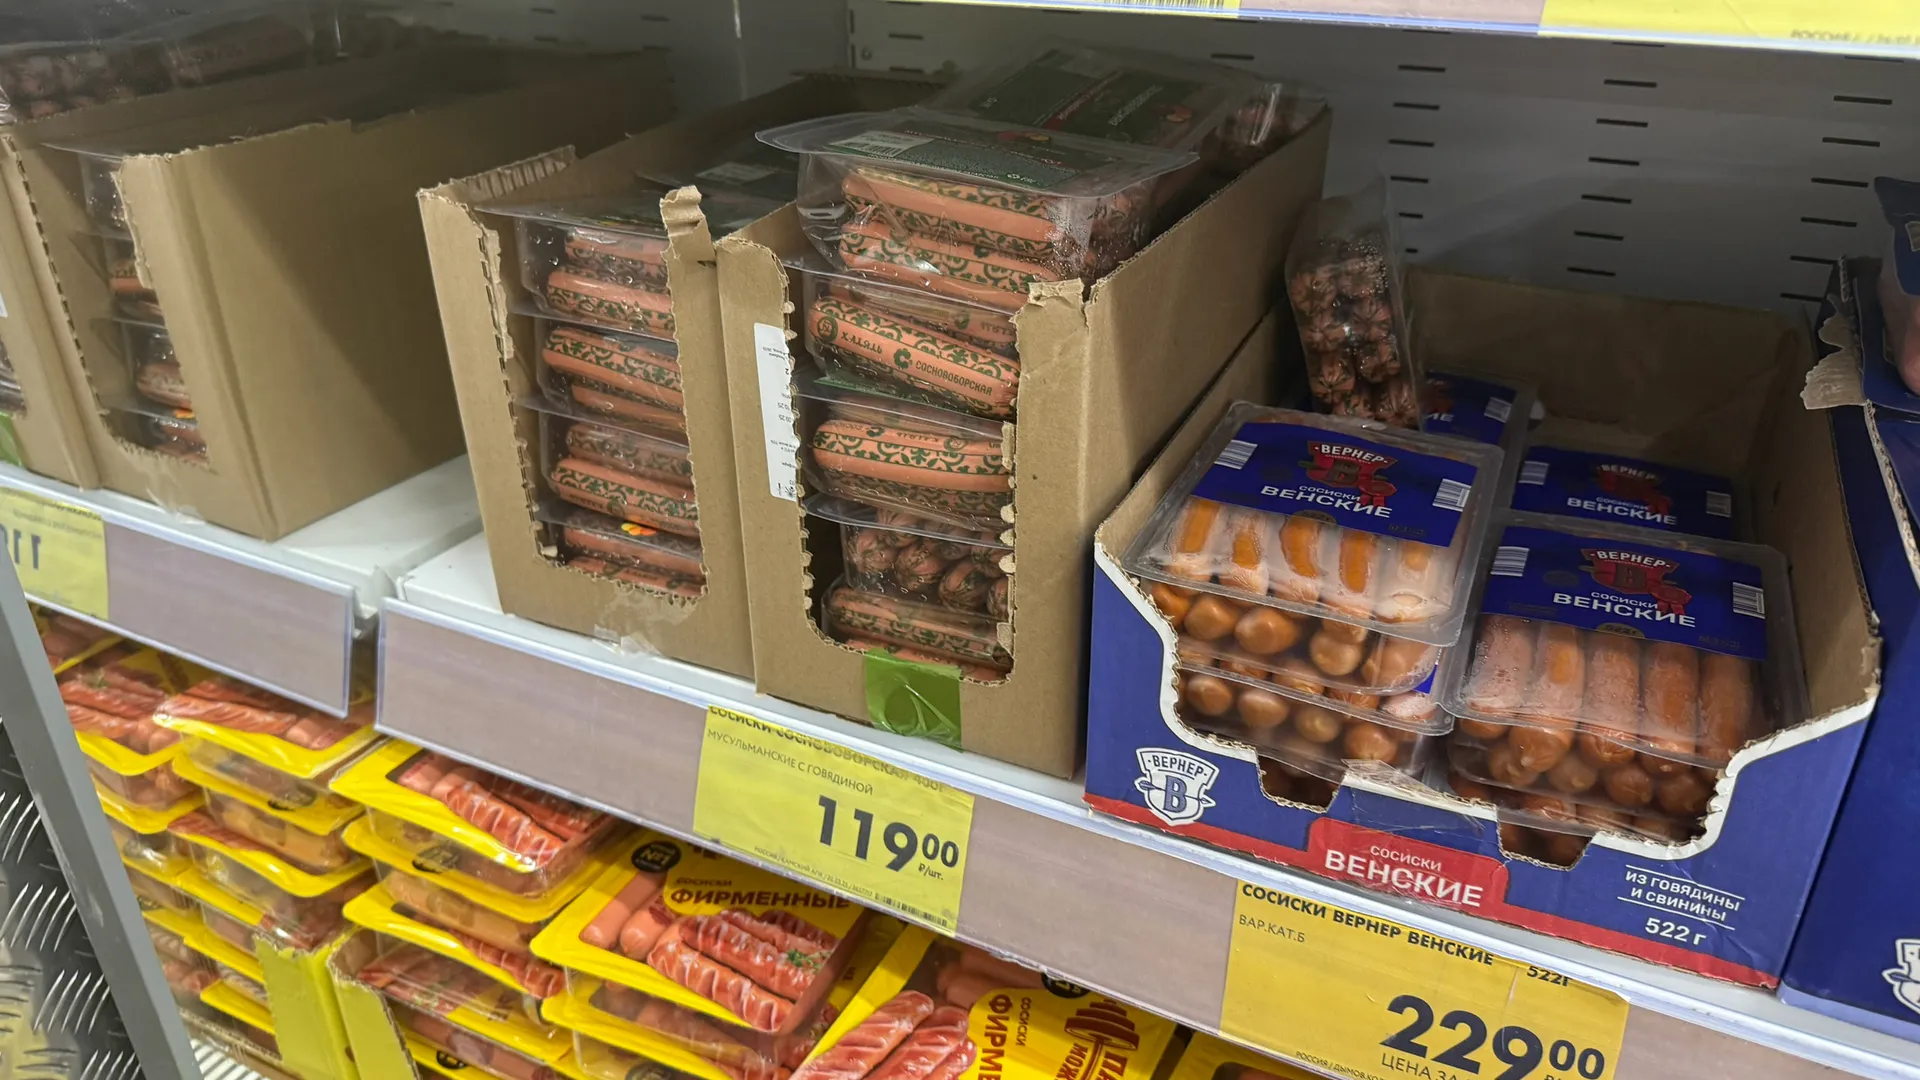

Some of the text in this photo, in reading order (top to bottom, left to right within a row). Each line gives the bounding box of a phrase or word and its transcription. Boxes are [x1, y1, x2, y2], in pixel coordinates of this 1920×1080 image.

[915, 360, 993, 396] СОСНОВОБОРСКАЯ
[1321, 444, 1384, 464] ВЕРНЕР
[1260, 485, 1393, 519] ВЕНСКИЕ
[1299, 485, 1361, 501] СОСИСКИ
[1566, 497, 1677, 526] ВЕНСКИЕ
[1596, 550, 1664, 568] ВЕРНЕР
[1553, 592, 1696, 628] ВЕНСКИЕ
[1591, 591, 1658, 609] СОСИСКИ
[707, 728, 874, 796] МУСУЛЬМАНСКИЕ С ГОВЯДИНОЙ
[1152, 755, 1204, 777] ВЕРНЕР
[1163, 775, 1188, 814] В
[818, 795, 960, 872] 119 00
[1369, 844, 1442, 872] СОСИСКИ
[676, 877, 733, 887] СОСИСКИ
[1324, 849, 1484, 908] ВЕНСКИЕ
[1625, 870, 1741, 912] ИЗ ГОВЯДИНЫ
[670, 888, 850, 910] ФИРМЕННЫЕ
[1631, 887, 1727, 923] И СВИНИНЫ
[1239, 914, 1306, 943] ВАР.КАТ.Б
[1242, 883, 1327, 918] СОСИСКИ
[1332, 909, 1402, 939] ВЕРНЕР
[1406, 931, 1495, 966] ВЕНСКИЕ
[1644, 916, 1688, 943] 522
[1016, 996, 1032, 1047] СОСИСКИ
[1379, 994, 1605, 1080] 229 00
